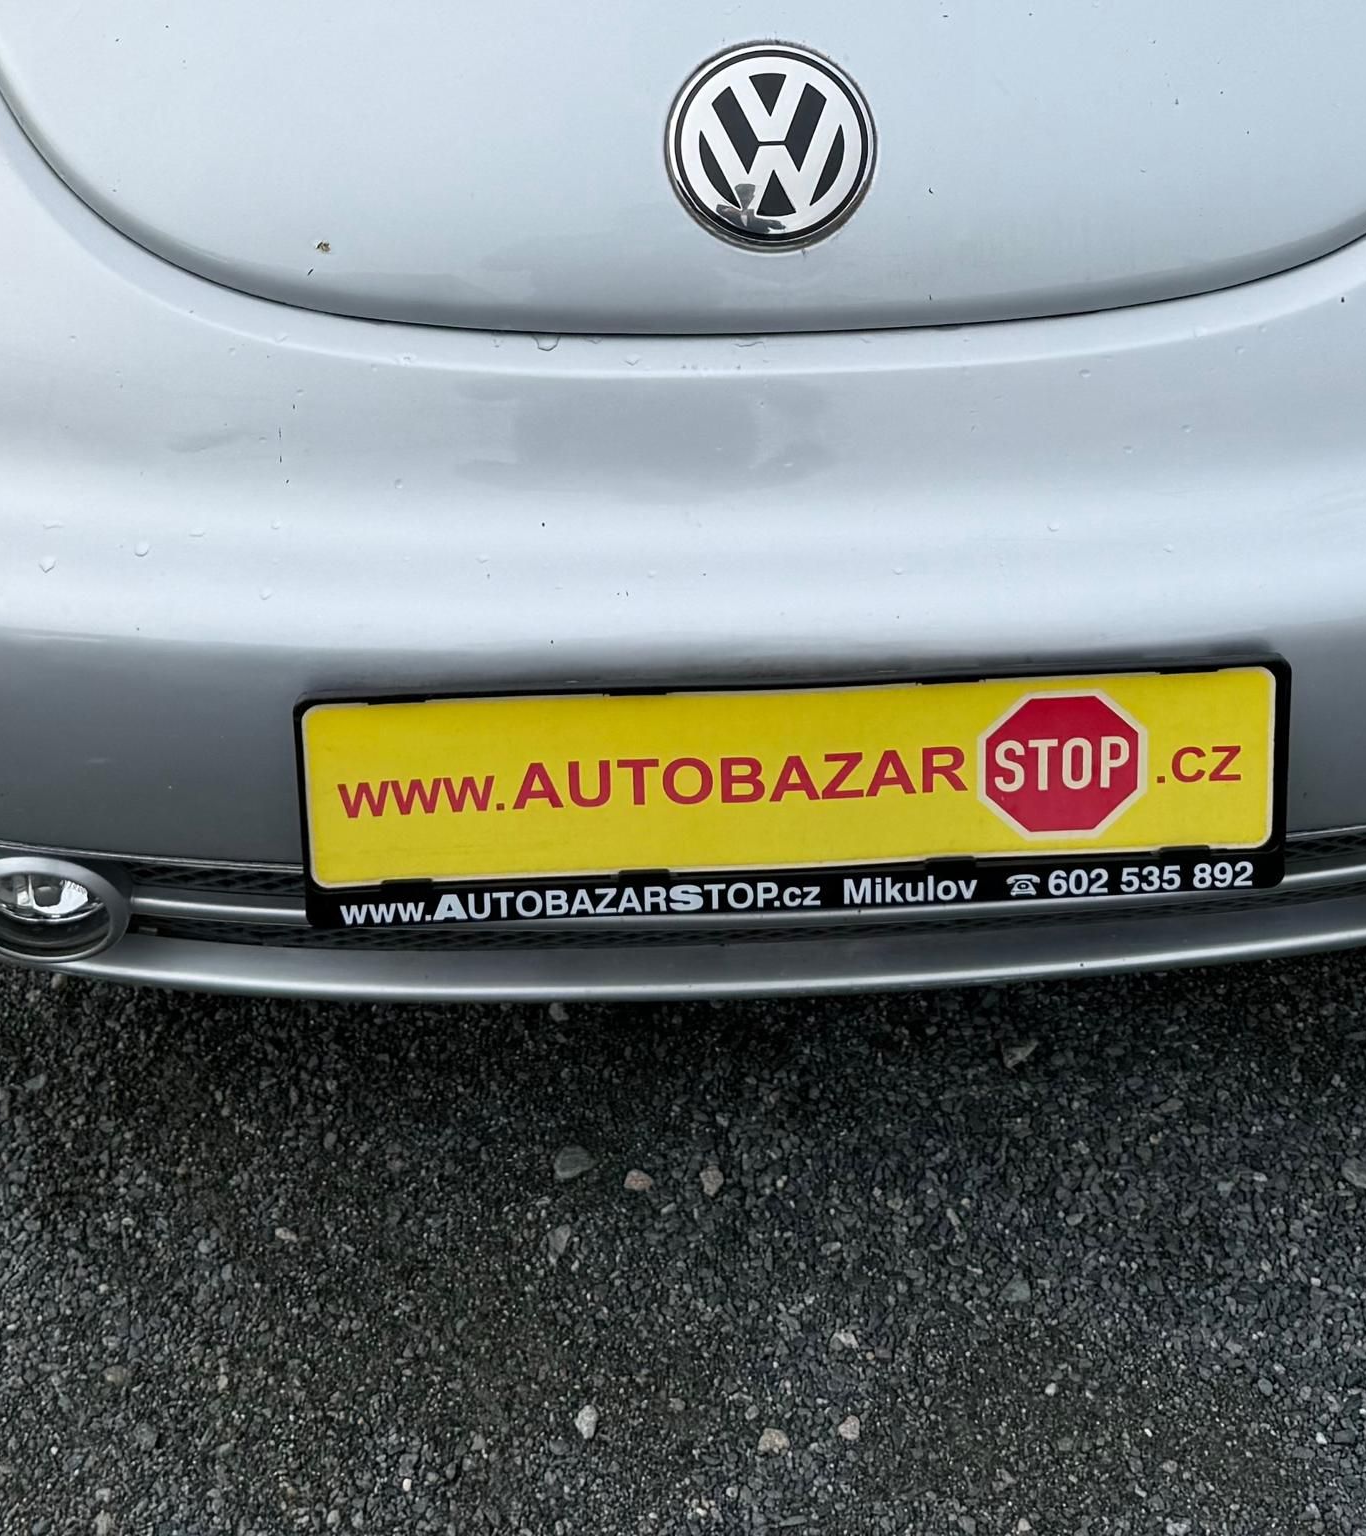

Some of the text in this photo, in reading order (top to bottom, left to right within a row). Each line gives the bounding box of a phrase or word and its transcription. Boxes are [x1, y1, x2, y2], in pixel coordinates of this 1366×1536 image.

[994, 735, 1131, 793] STOP
[843, 876, 978, 905] Mikulov
[1047, 869, 1109, 896] 602
[1120, 865, 1181, 894] 535
[1192, 862, 1254, 890] 892
